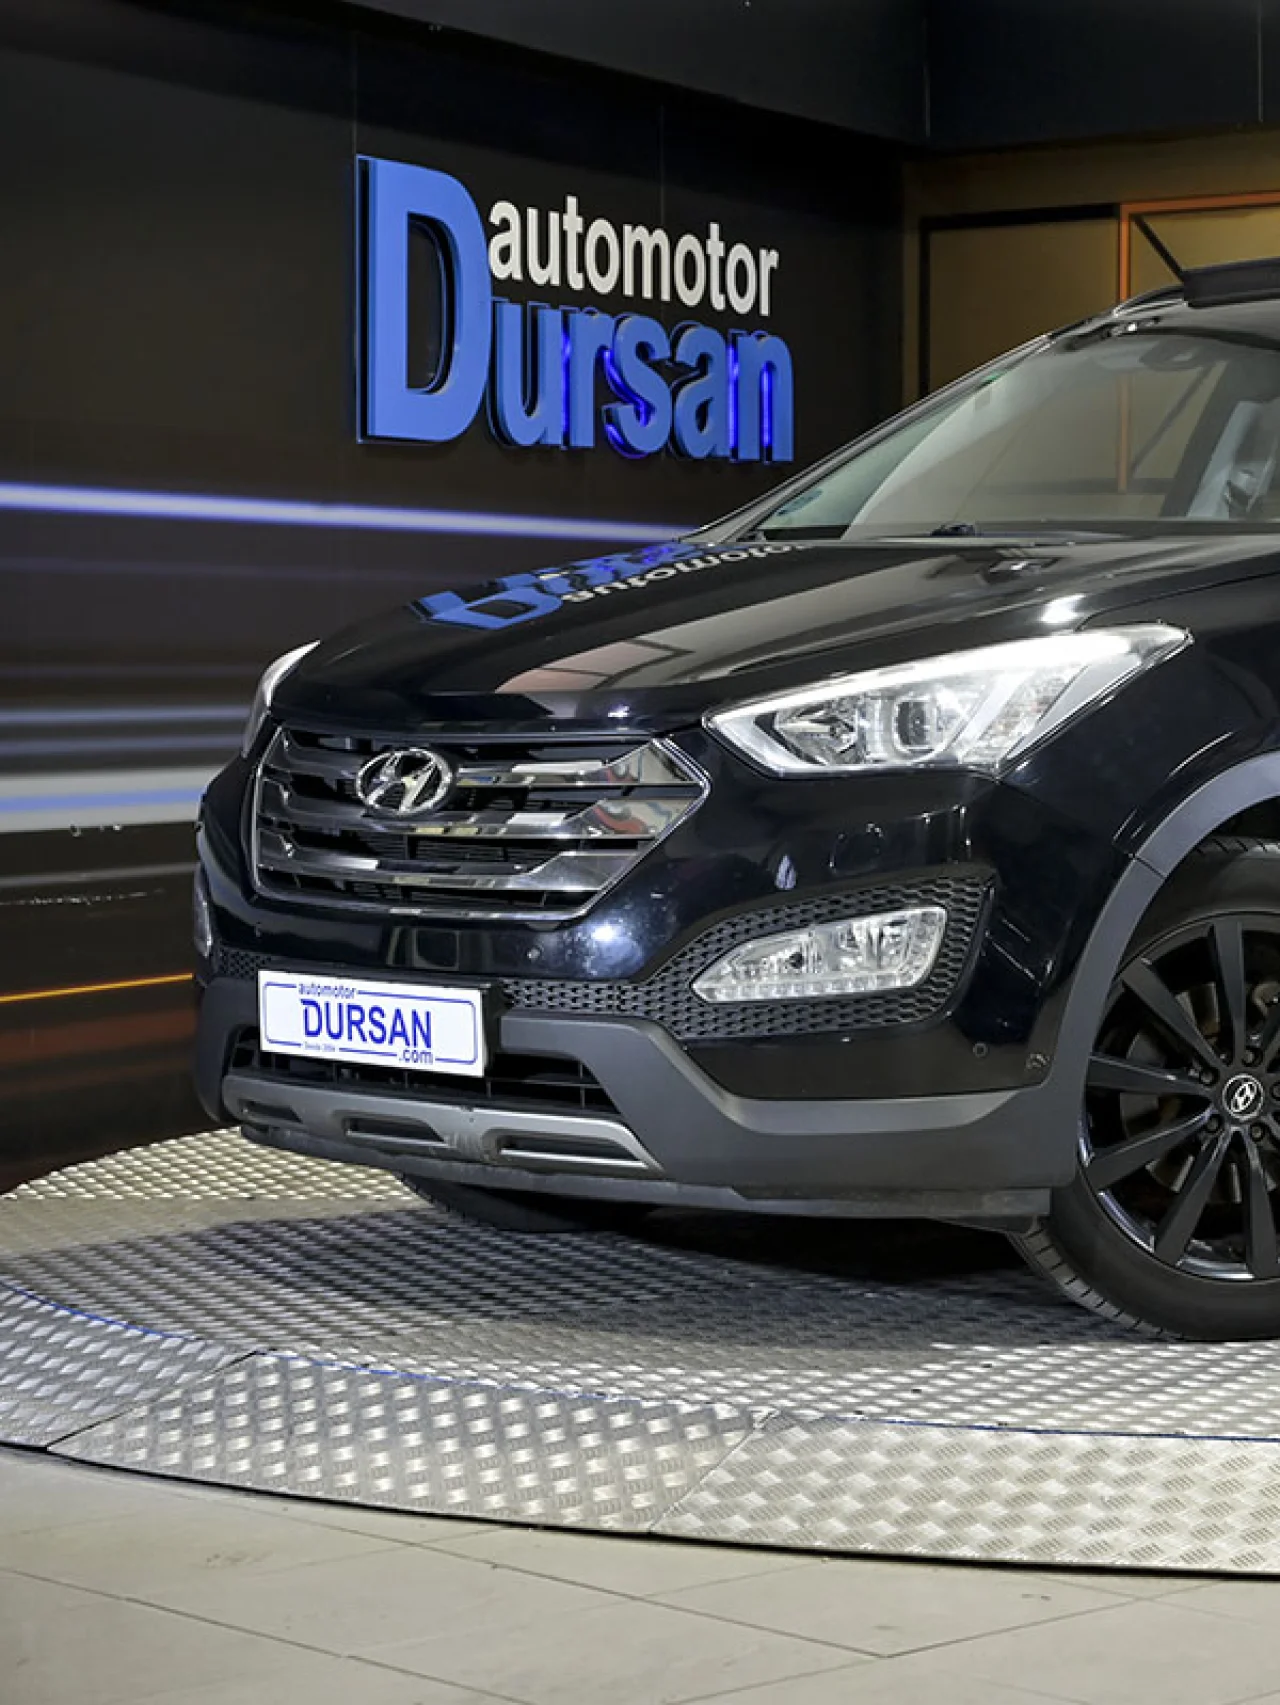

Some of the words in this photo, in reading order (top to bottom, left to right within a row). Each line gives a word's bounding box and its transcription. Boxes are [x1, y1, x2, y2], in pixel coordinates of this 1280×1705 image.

[489, 195, 779, 316] automotor
[355, 154, 796, 463] Dursan
[298, 983, 357, 999] automotor
[300, 998, 432, 1049] DURSAN
[398, 1048, 434, 1064] .com
